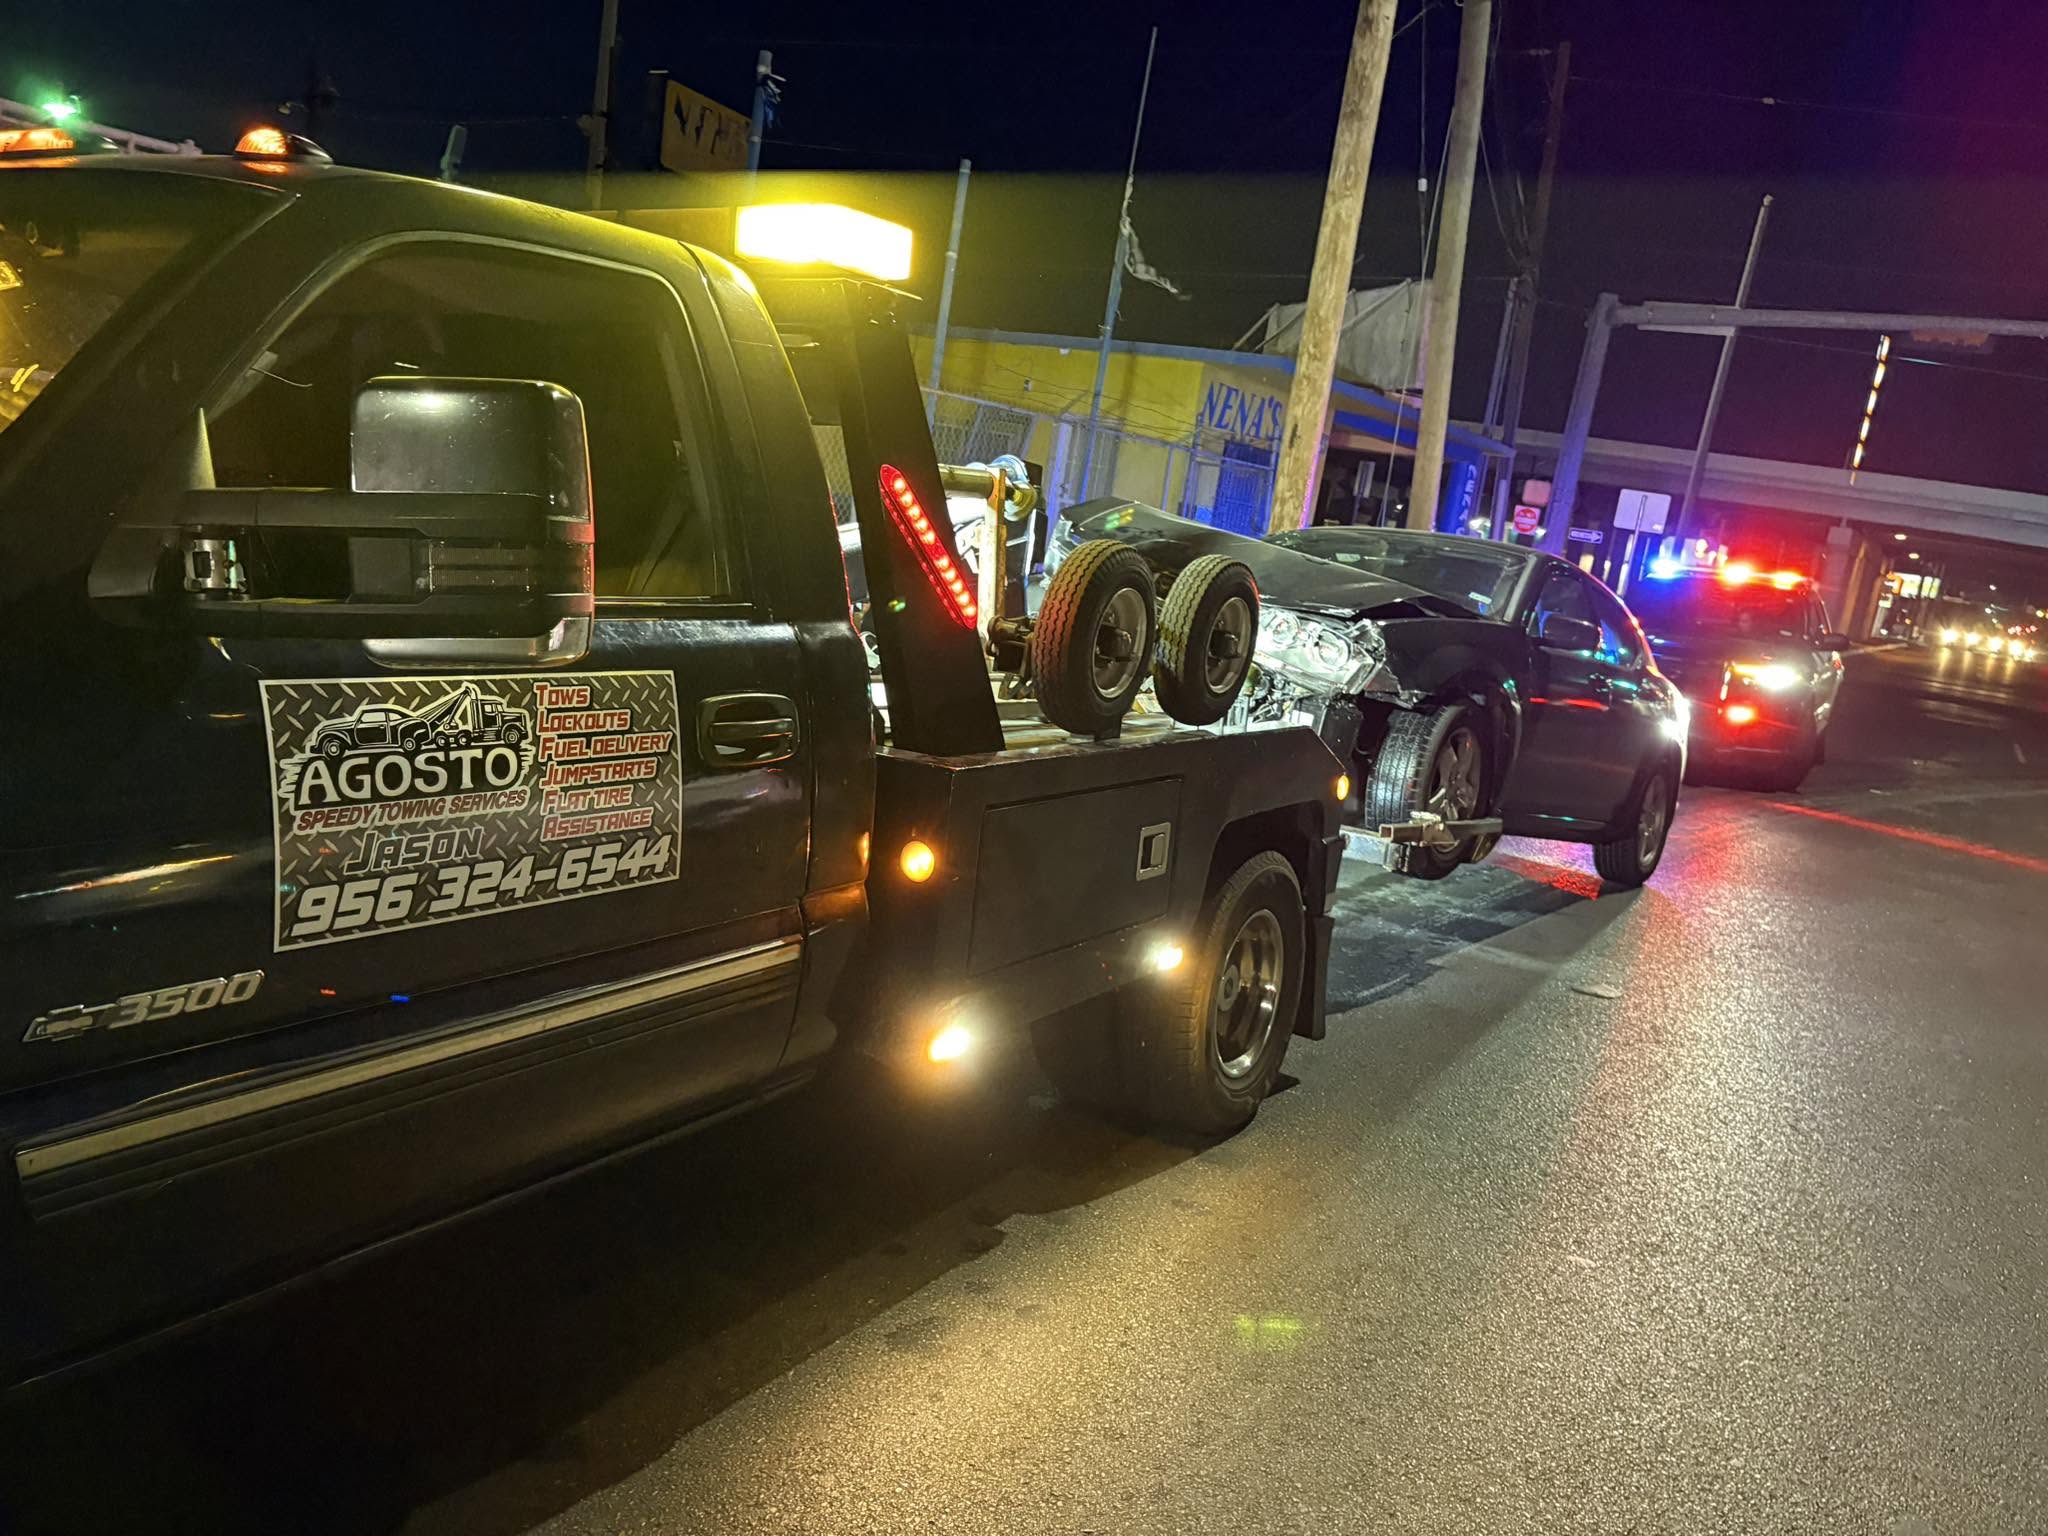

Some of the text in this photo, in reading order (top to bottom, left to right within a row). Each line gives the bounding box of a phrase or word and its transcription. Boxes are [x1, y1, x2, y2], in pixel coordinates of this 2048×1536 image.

[1202, 381, 1284, 441] NENA'S
[534, 683, 589, 707] TOWS
[537, 708, 630, 733] LOCKOUTS
[540, 732, 672, 761] FUEL DELIVERY
[298, 748, 519, 806] AGOSTO
[540, 759, 656, 788] JUMPSTARTS
[298, 789, 528, 830] SPEEDY TOWING SERVICES
[541, 785, 632, 815] FLAT TIRE
[542, 808, 653, 841] ASSISTANCE
[345, 827, 484, 875] JASON
[291, 835, 671, 937] 956 324-6544
[108, 969, 264, 1029] 3500
